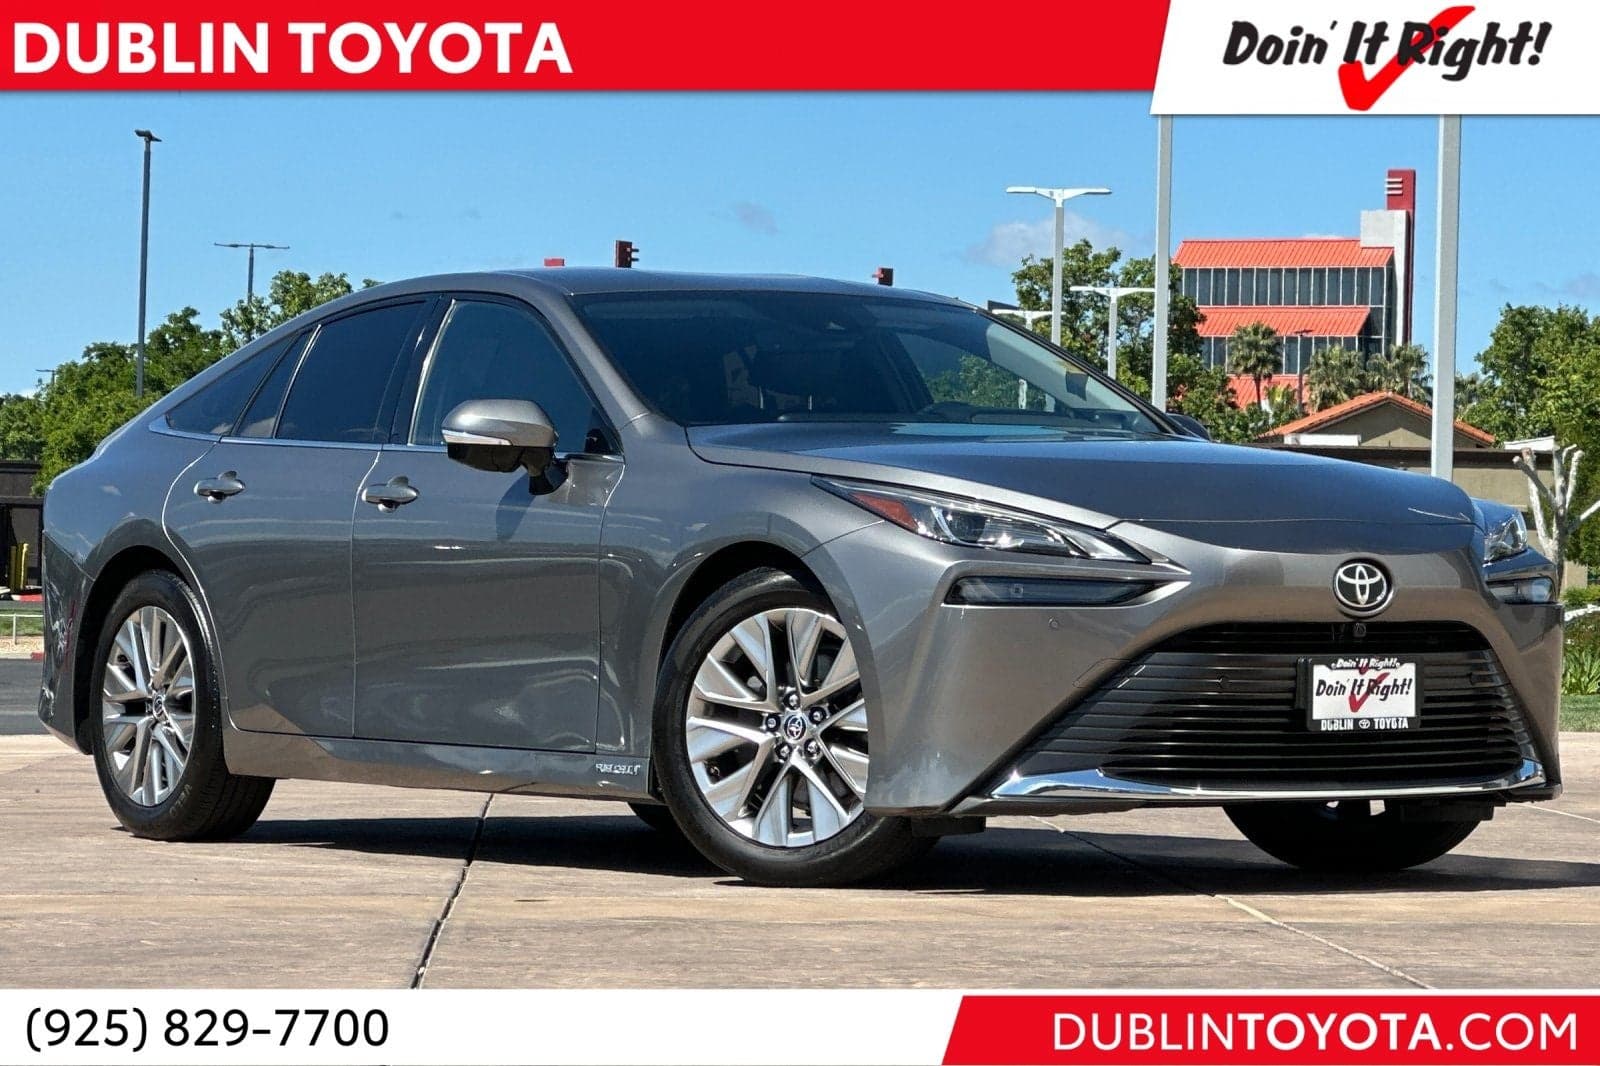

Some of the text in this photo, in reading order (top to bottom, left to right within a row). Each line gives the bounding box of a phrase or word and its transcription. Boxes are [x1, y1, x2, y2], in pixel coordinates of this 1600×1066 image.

[1352, 678, 1364, 696] It
[1367, 678, 1412, 701] Right!
[1321, 718, 1408, 731] DUBLIN TOYOTA
